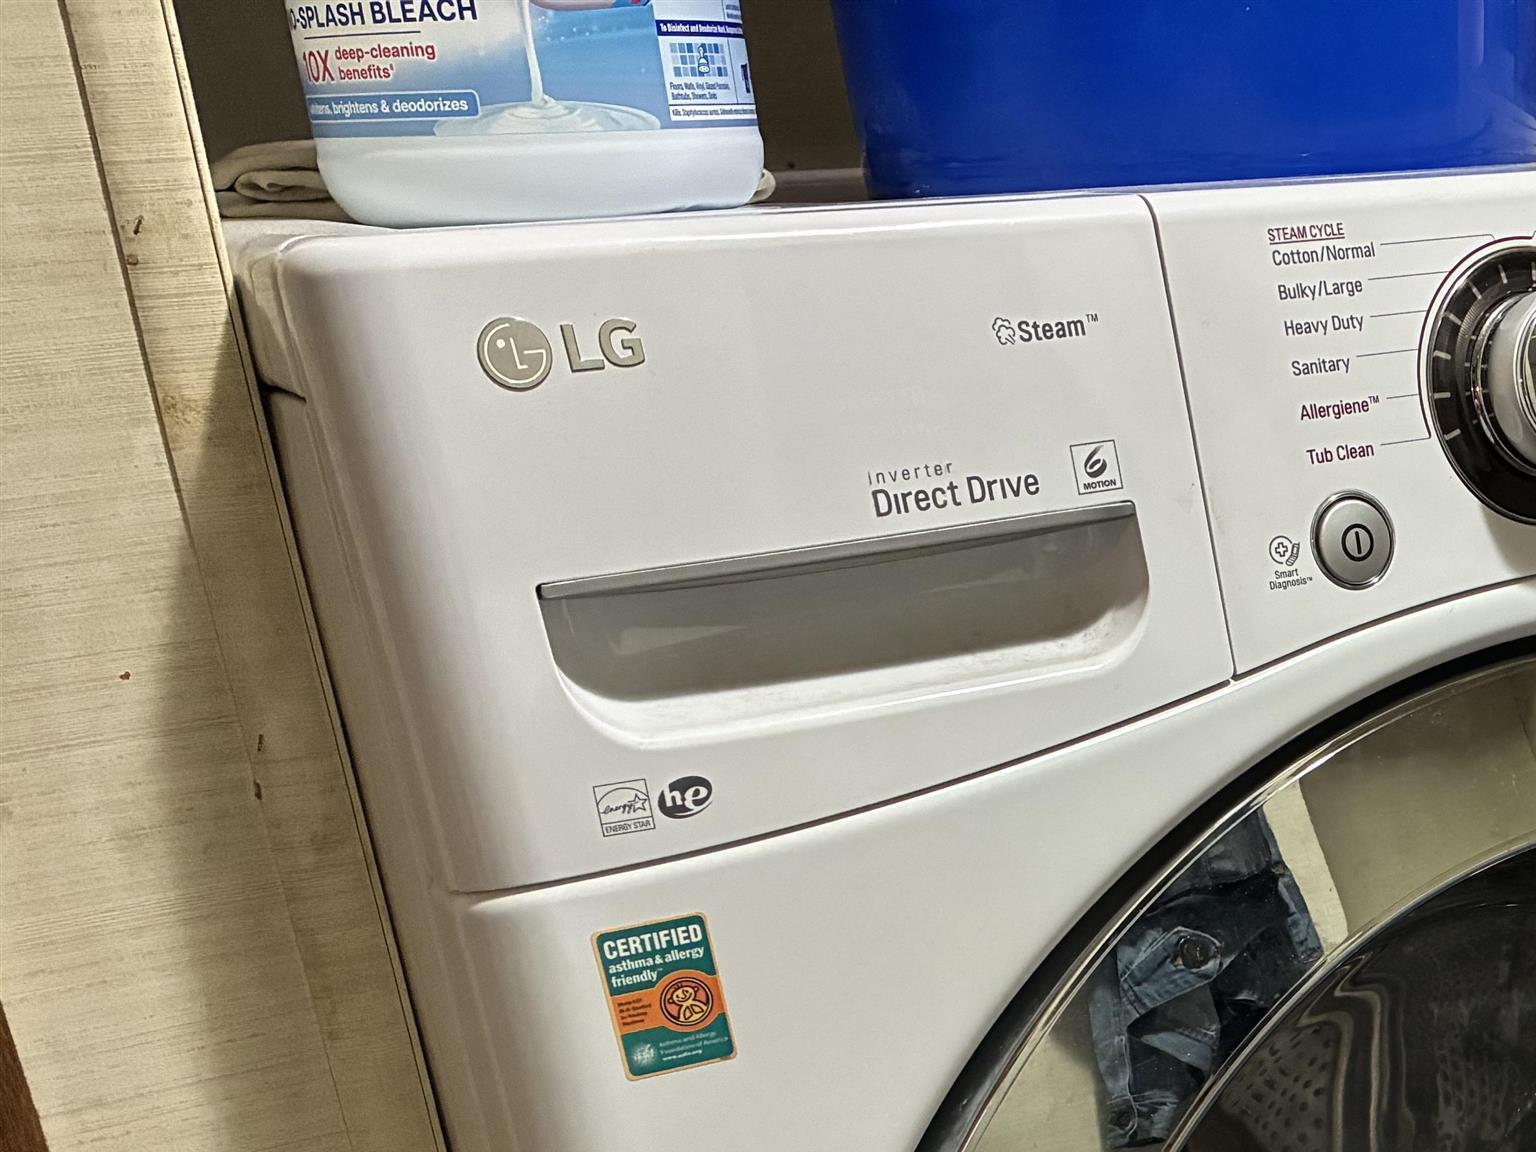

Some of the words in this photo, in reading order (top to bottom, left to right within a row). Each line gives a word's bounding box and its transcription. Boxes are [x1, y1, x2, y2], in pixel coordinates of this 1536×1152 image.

[370, 0, 478, 24] BLEACH
[303, 49, 335, 82] 10X
[335, 42, 436, 62] deep-cleaning
[332, 100, 378, 118] brightens
[380, 100, 390, 113] &
[392, 97, 468, 113] deodorizes
[1267, 226, 1306, 242] STEAM
[1309, 223, 1345, 238] CYCLE
[1272, 242, 1376, 266] Cotton/Normal
[1278, 279, 1363, 301] Bulky/Large
[1284, 318, 1328, 337] Heavy
[1332, 314, 1364, 332] Duty
[560, 318, 645, 373] LG
[1291, 357, 1350, 377] Sanitary
[1306, 448, 1333, 465] Tub
[1336, 443, 1375, 461] Clean
[871, 480, 962, 517] Direct
[966, 473, 1040, 504] Drive
[1083, 479, 1117, 490] MOTION
[1274, 568, 1299, 580] Smart
[661, 780, 710, 814] he
[605, 821, 632, 834] ENERGY
[633, 820, 652, 830] STAR
[603, 924, 703, 960] CERTIFIED
[608, 957, 654, 974] asthma
[654, 954, 664, 965] &
[664, 946, 705, 963] allergy
